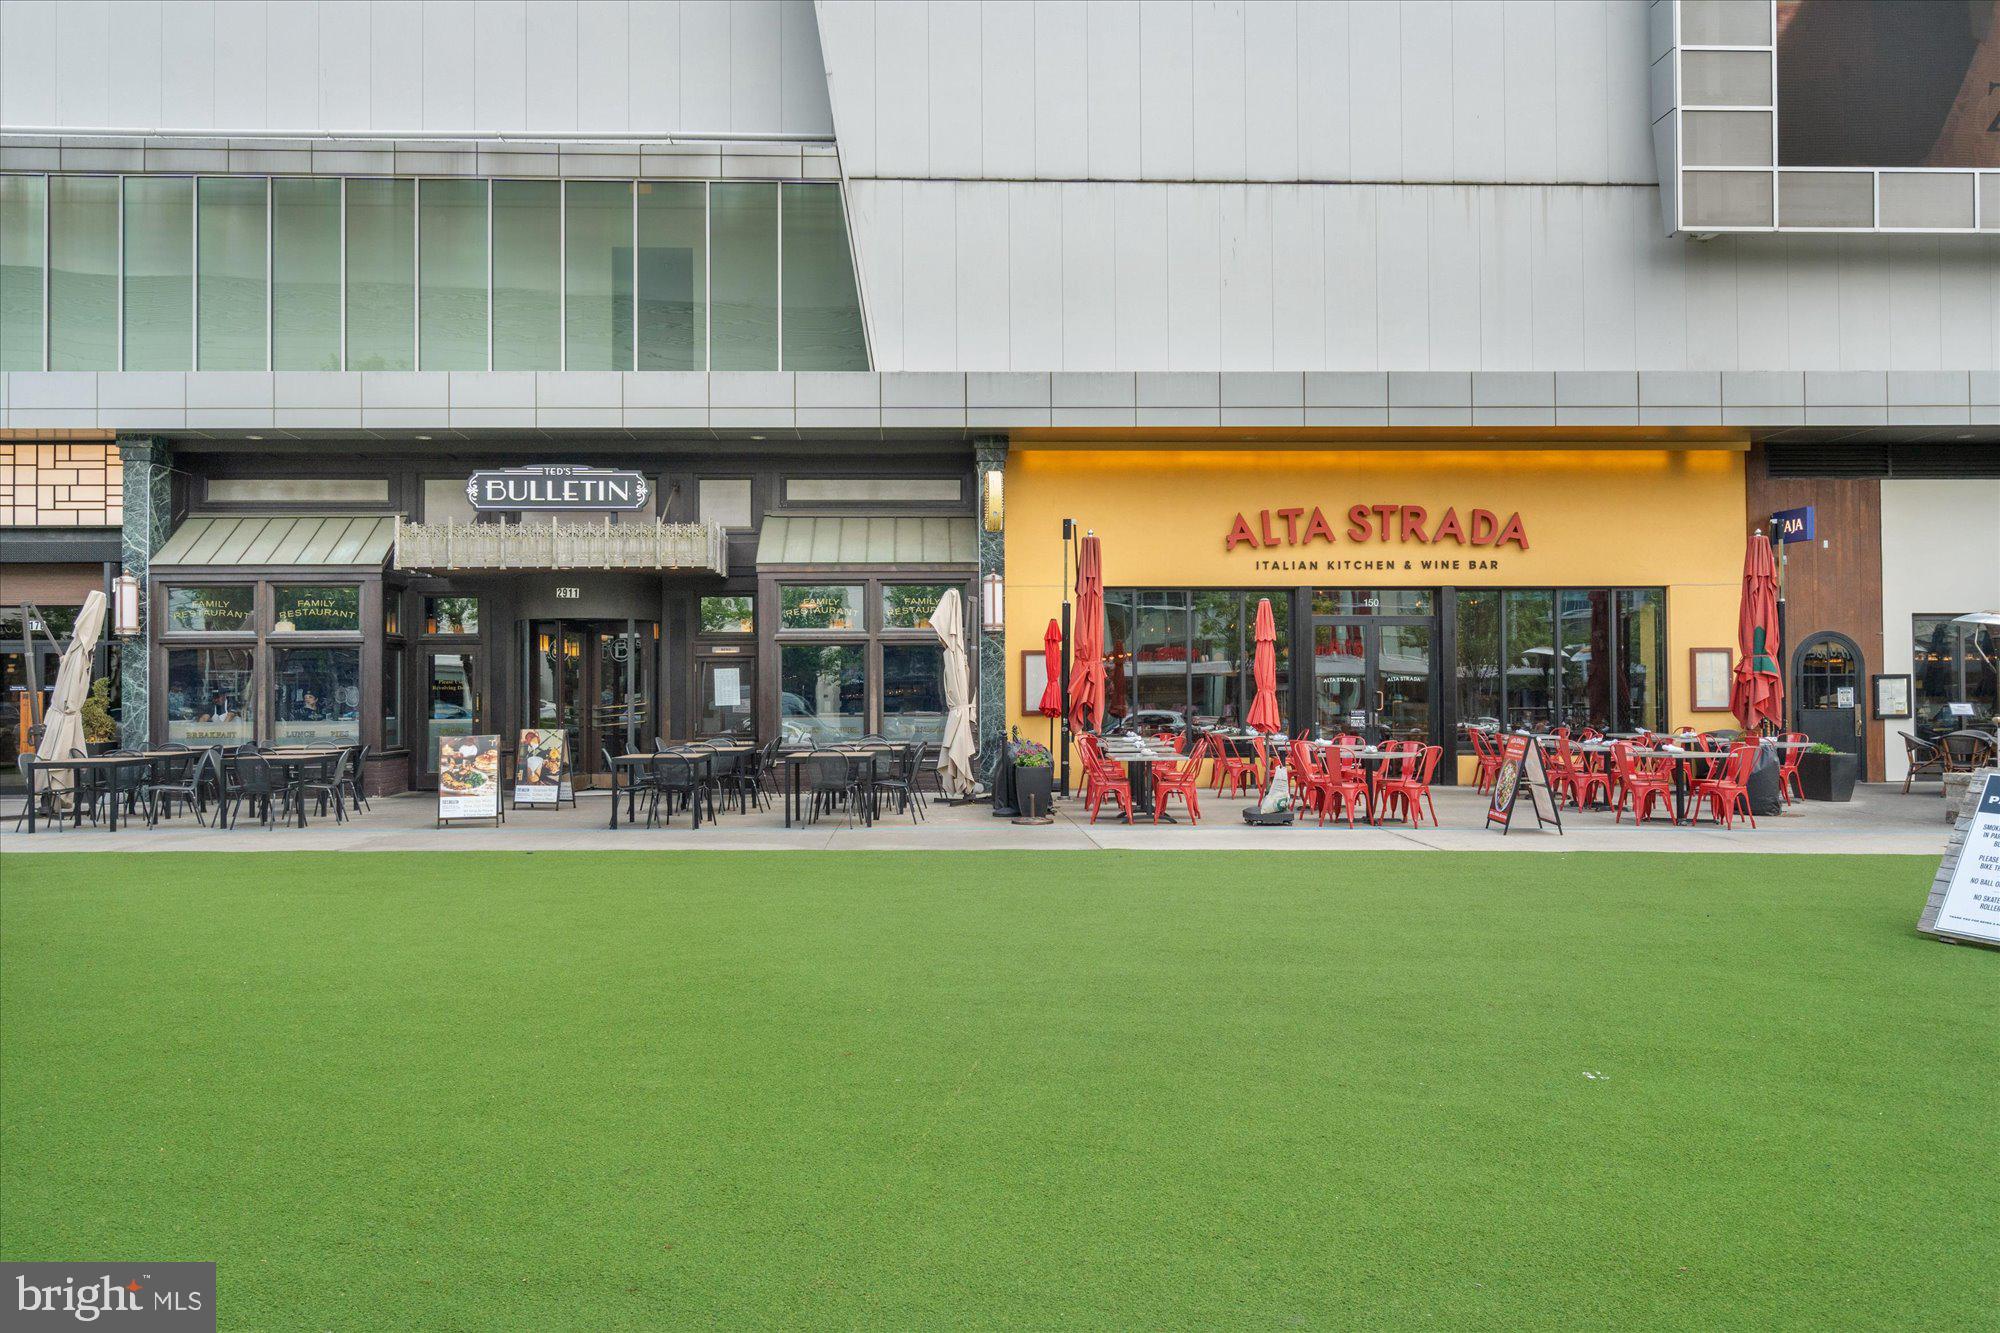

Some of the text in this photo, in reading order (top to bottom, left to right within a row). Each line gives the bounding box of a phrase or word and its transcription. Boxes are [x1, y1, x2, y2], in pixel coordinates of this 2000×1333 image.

[544, 468, 571, 476] TED'S
[485, 480, 629, 501] BULLETIN
[1226, 504, 1531, 552] ALTA STRADA
[1256, 560, 1499, 570] ITALIAN KITCHEN & WINE BAR
[557, 588, 579, 598] 2911
[803, 598, 840, 606] FAMILY
[1363, 598, 1380, 608] 150
[173, 609, 250, 620] RESTAURANT
[279, 608, 356, 620] RESTAURANT
[784, 606, 859, 617] RESTAURANT
[1978, 854, 2000, 863] PLEASE
[1980, 863, 1993, 871] BIKE
[1970, 877, 1979, 885] NO
[1980, 878, 1994, 887] BALL
[1973, 893, 1982, 901] NO
